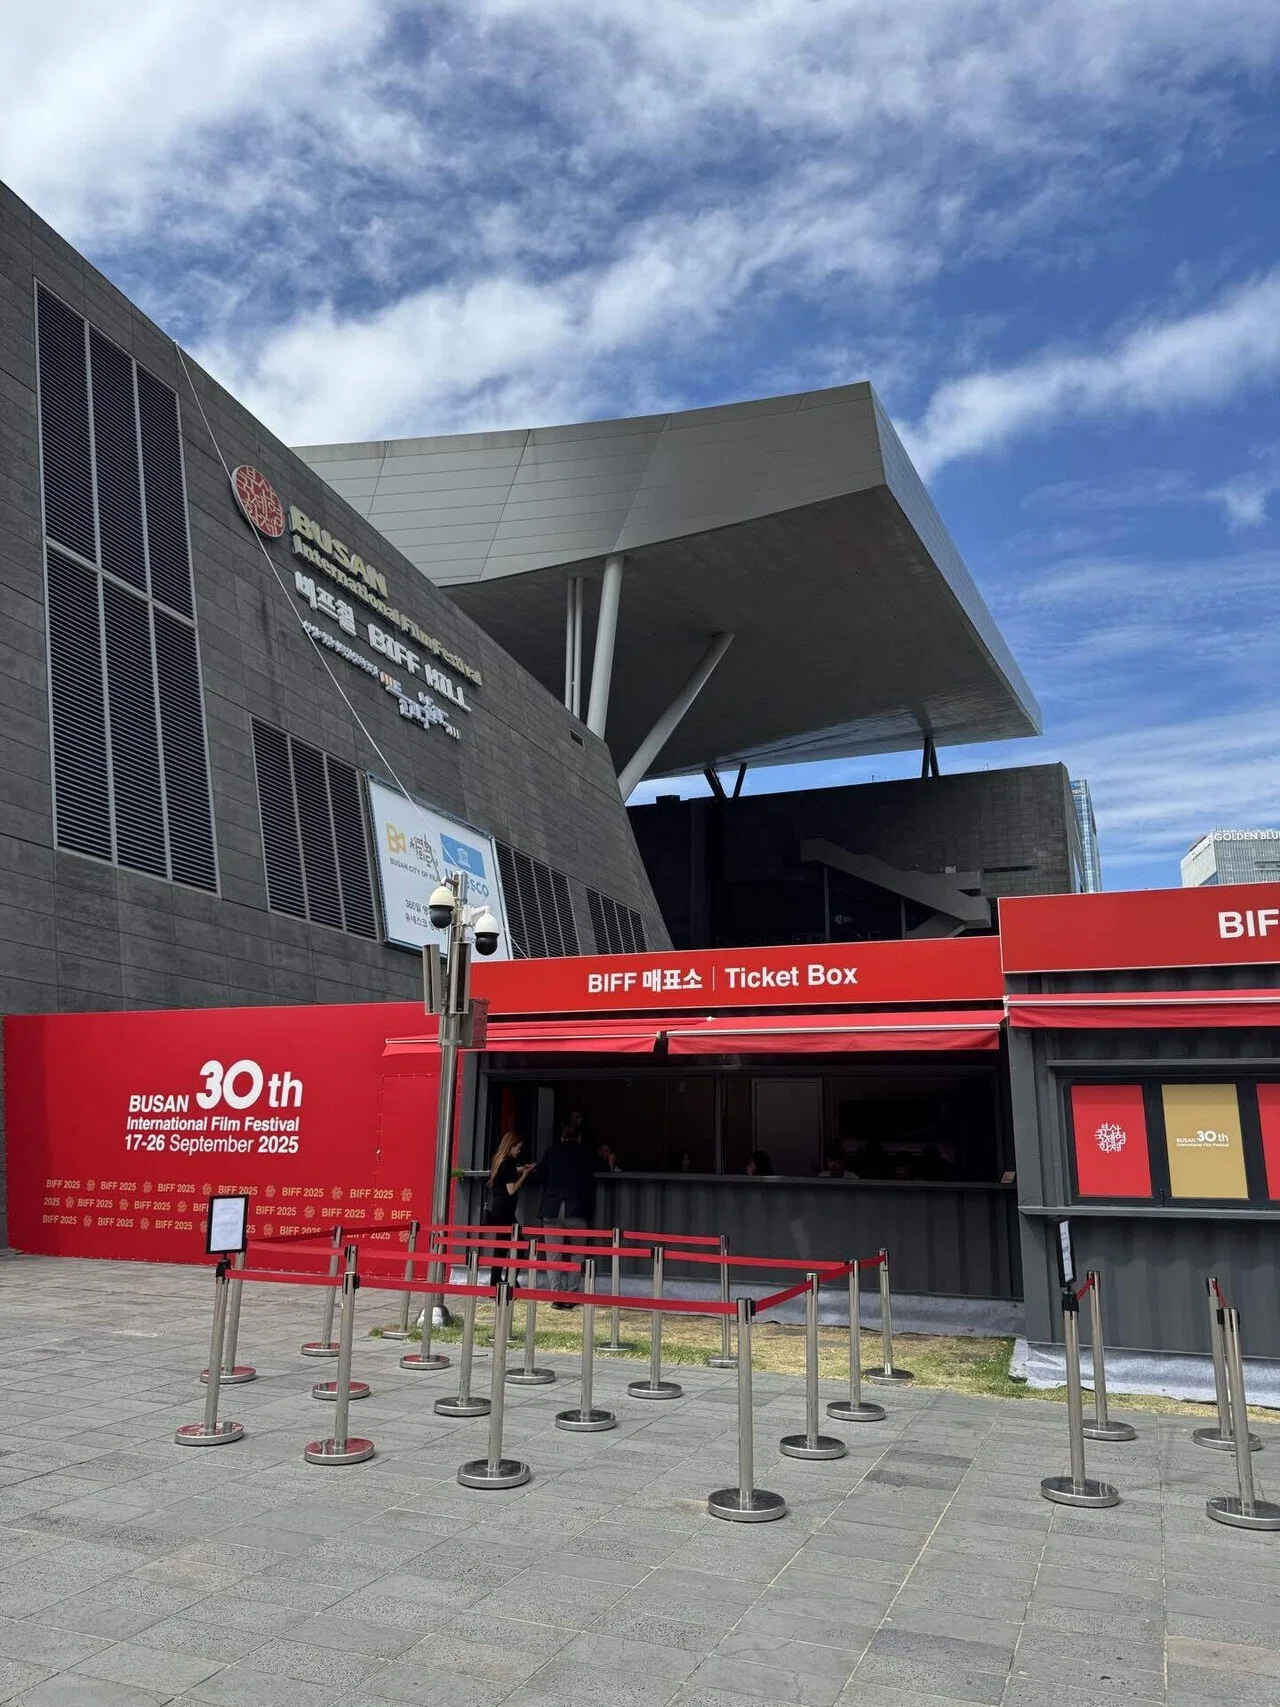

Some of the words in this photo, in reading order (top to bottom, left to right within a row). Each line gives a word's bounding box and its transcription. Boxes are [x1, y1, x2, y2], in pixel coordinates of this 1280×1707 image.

[289, 505, 388, 598] BUSAN
[293, 535, 401, 625] International
[432, 638, 482, 687] Festival
[295, 571, 357, 637] 비프힐
[368, 623, 421, 674] BIFF
[425, 663, 472, 712] HILL
[1214, 832, 1258, 841] GOLDEN
[1261, 831, 1280, 840] BLU
[588, 972, 637, 993] BIFF
[642, 968, 703, 993] 매표소
[724, 966, 799, 988] Ticket
[807, 964, 859, 986] Box
[129, 1095, 189, 1113] BUSAN
[126, 1116, 206, 1131] International
[211, 1117, 240, 1131] Film
[244, 1117, 300, 1132] Festival
[125, 1134, 165, 1151] 17-26
[169, 1134, 254, 1156] September
[258, 1135, 299, 1154] 2025
[46, 1179, 63, 1188] BIFF
[64, 1180, 81, 1189] 2025
[101, 1181, 118, 1190] BIFF
[119, 1182, 137, 1191] 2025
[157, 1183, 176, 1192] BIFF
[177, 1183, 196, 1193] 2025
[218, 1185, 238, 1194] BIFF
[239, 1186, 258, 1195] 2025
[282, 1187, 302, 1197] BIFF
[303, 1187, 324, 1198] 2025
[350, 1189, 371, 1198] BIFF
[373, 1189, 394, 1199] 2025
[43, 1197, 61, 1206] 2025
[77, 1198, 95, 1207] BIFF
[96, 1199, 113, 1209] 2025
[134, 1200, 152, 1210] BIFF
[153, 1201, 171, 1211] 2025
[255, 1205, 275, 1215] BIFF
[277, 1206, 297, 1216] 2025
[322, 1208, 343, 1218] BIFF
[344, 1208, 366, 1218] 2025
[391, 1210, 412, 1220] BIFF
[42, 1214, 60, 1224] BIFF
[60, 1215, 78, 1225] 2025
[98, 1217, 115, 1226] BIFF
[116, 1218, 134, 1228] 2025
[155, 1219, 173, 1229] BIFF
[174, 1220, 193, 1231] 2025
[280, 1225, 299, 1235] BIFF
